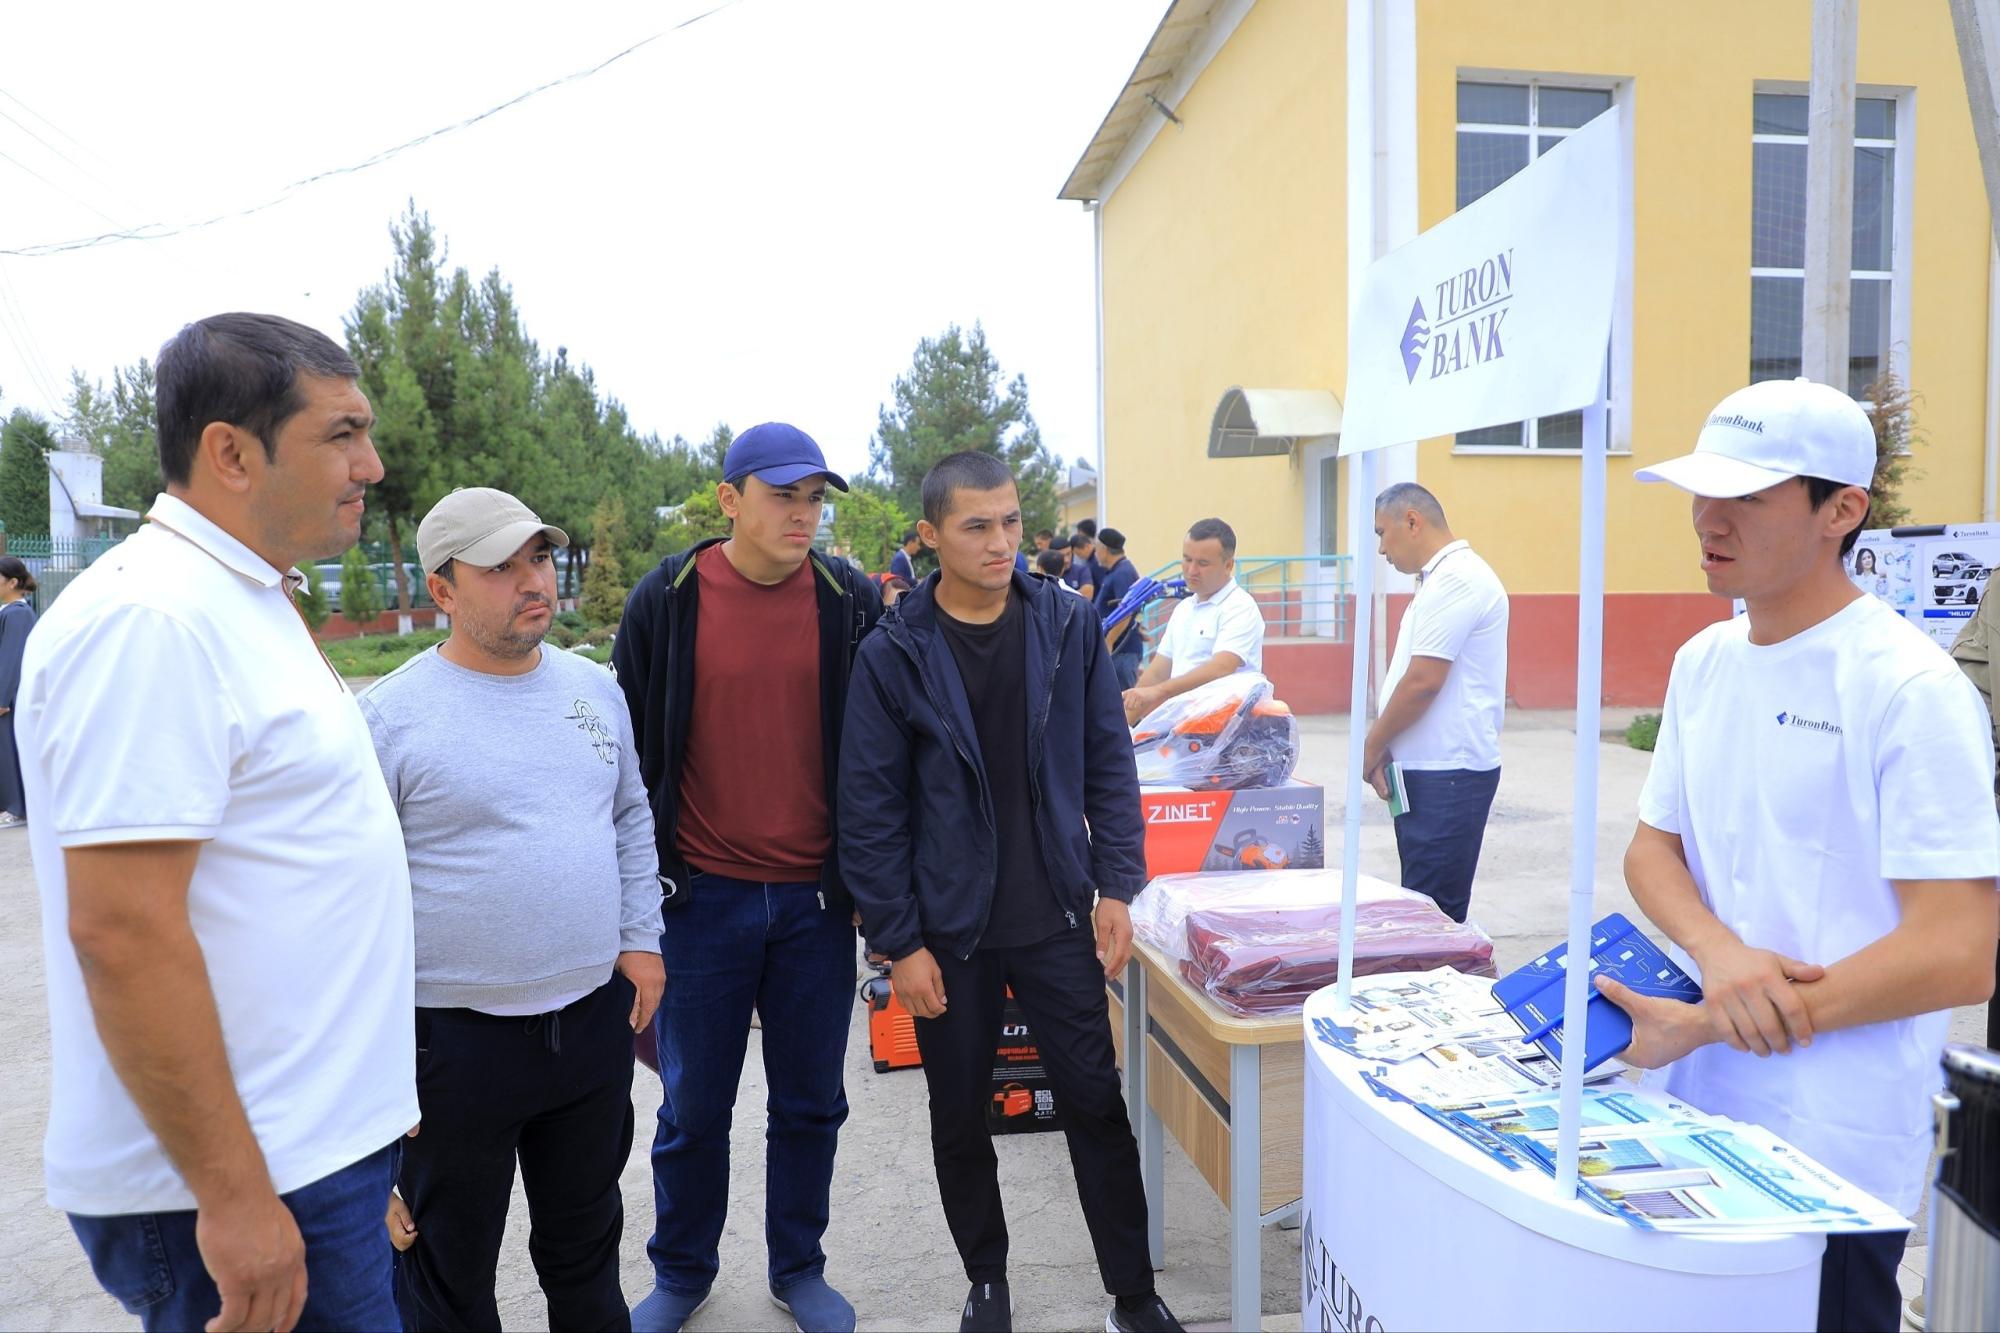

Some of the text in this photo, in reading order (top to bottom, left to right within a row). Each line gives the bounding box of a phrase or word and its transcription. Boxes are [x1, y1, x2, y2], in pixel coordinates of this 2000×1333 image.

[1436, 248, 1514, 321] TURON
[1430, 307, 1509, 379] BANK
[1790, 714, 1843, 735] TuronBan
